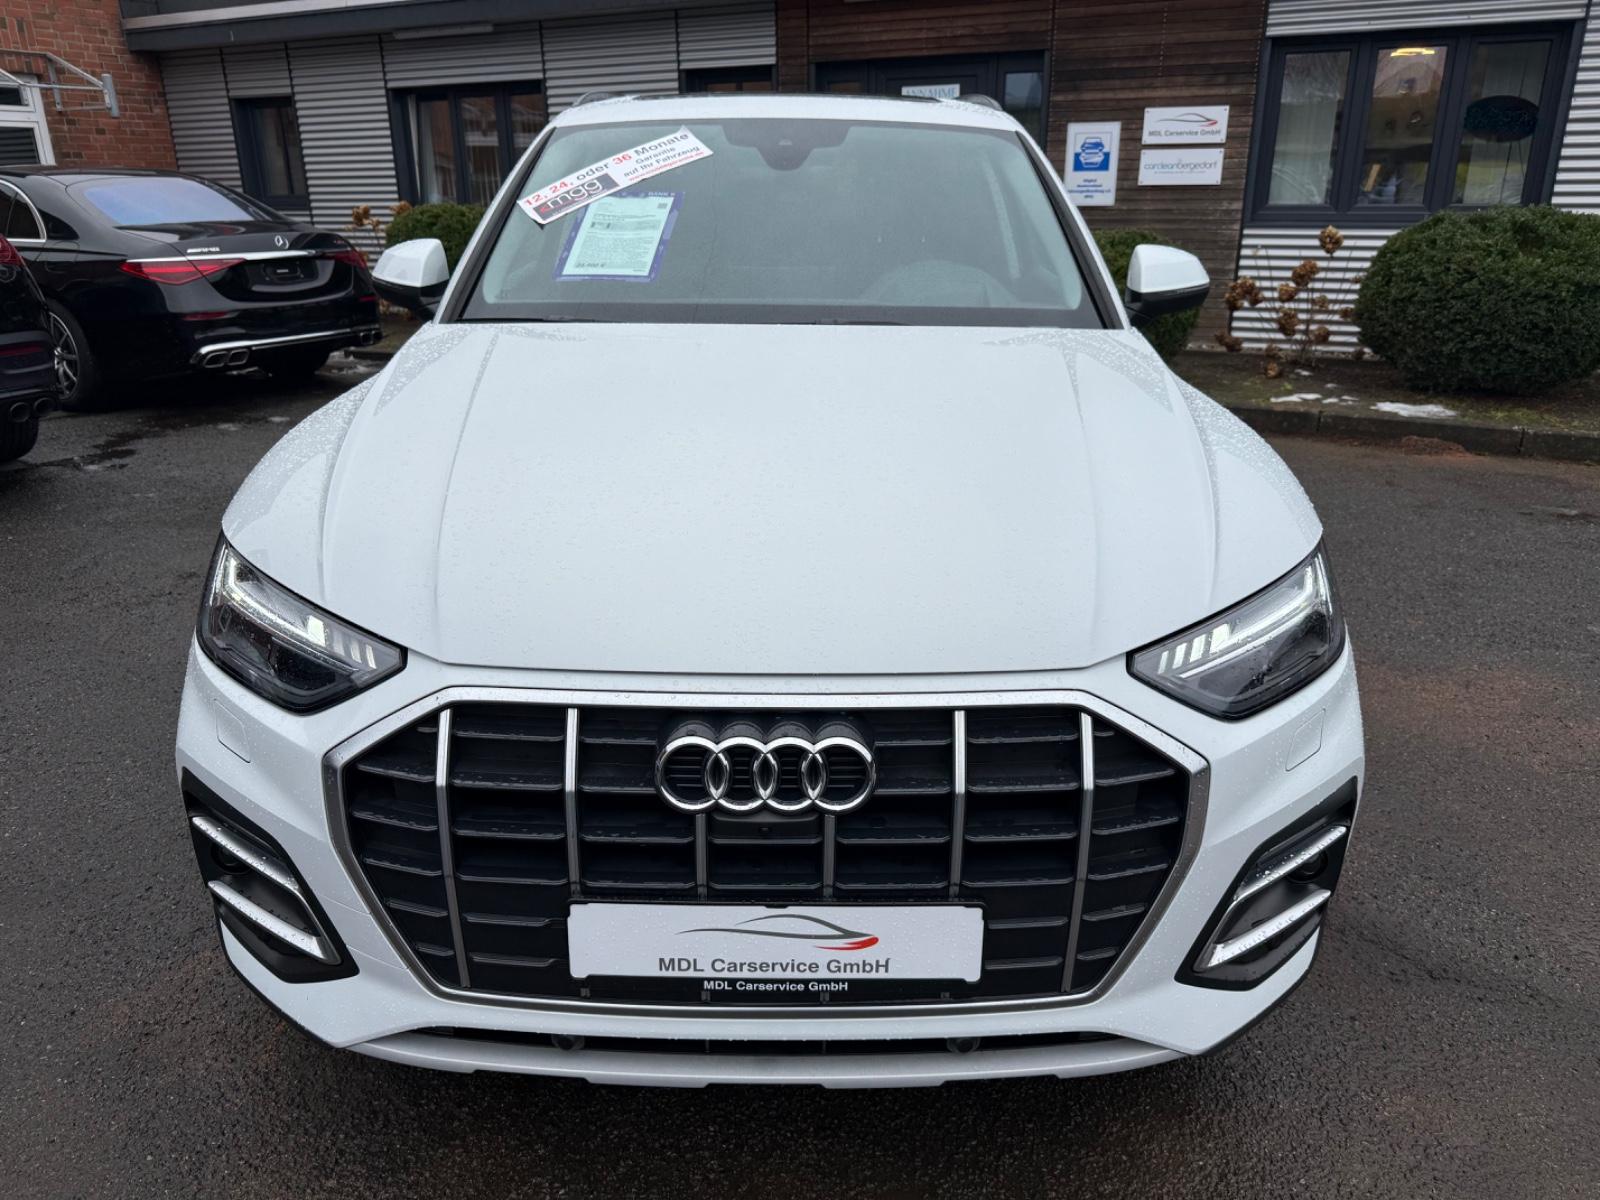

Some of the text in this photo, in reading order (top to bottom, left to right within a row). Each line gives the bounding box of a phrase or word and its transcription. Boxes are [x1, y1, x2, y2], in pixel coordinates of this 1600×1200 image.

[1164, 129, 1199, 137] Carservice
[1199, 128, 1221, 136] GmbH
[576, 162, 610, 181] oder
[612, 153, 633, 166] 36
[633, 133, 690, 157] Monate
[623, 167, 639, 178] auf
[655, 146, 700, 165] Fahrzeug
[635, 147, 676, 164] Garantie
[658, 956, 890, 974] MDL Carservice GmbH
[703, 980, 849, 992] MDL Carservice GmbH
